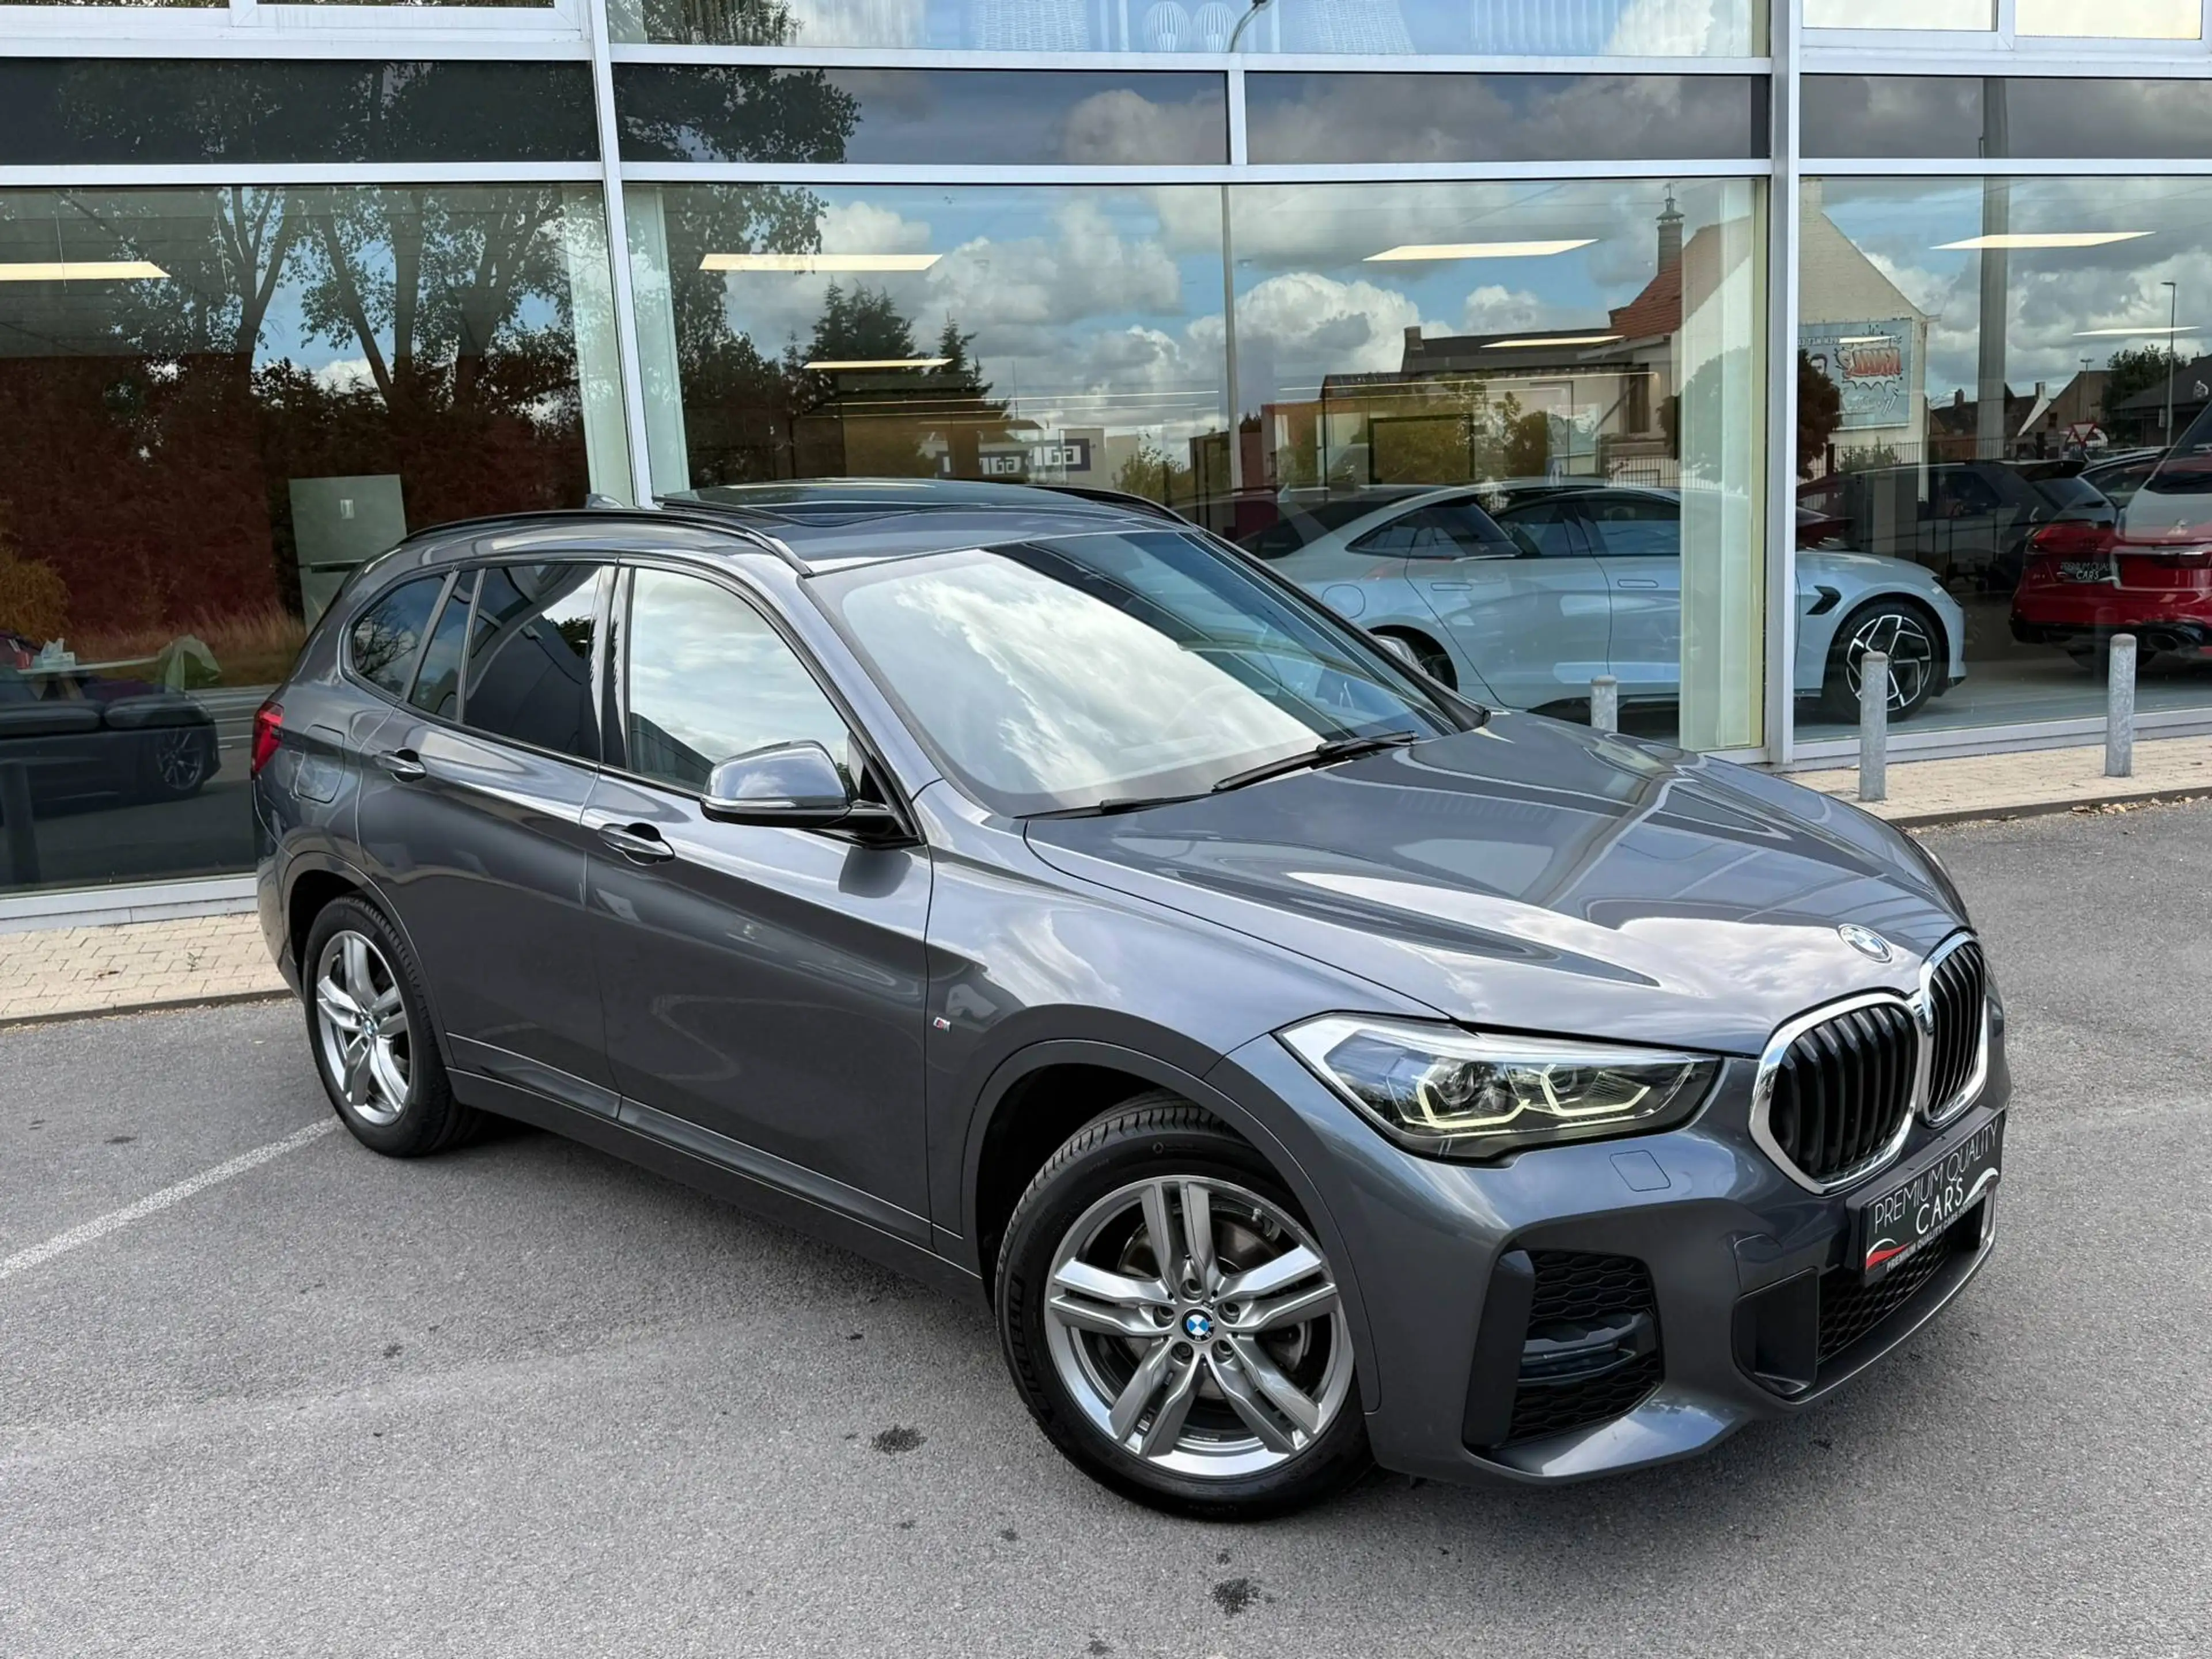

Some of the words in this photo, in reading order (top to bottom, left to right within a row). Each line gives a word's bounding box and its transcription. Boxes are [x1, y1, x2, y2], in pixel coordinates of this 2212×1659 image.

[2075, 570, 2100, 580] CARS
[1874, 1162, 1944, 1234] PREMIUM
[1946, 1118, 1998, 1185] QUALITY
[1915, 1177, 1964, 1234] CARS
